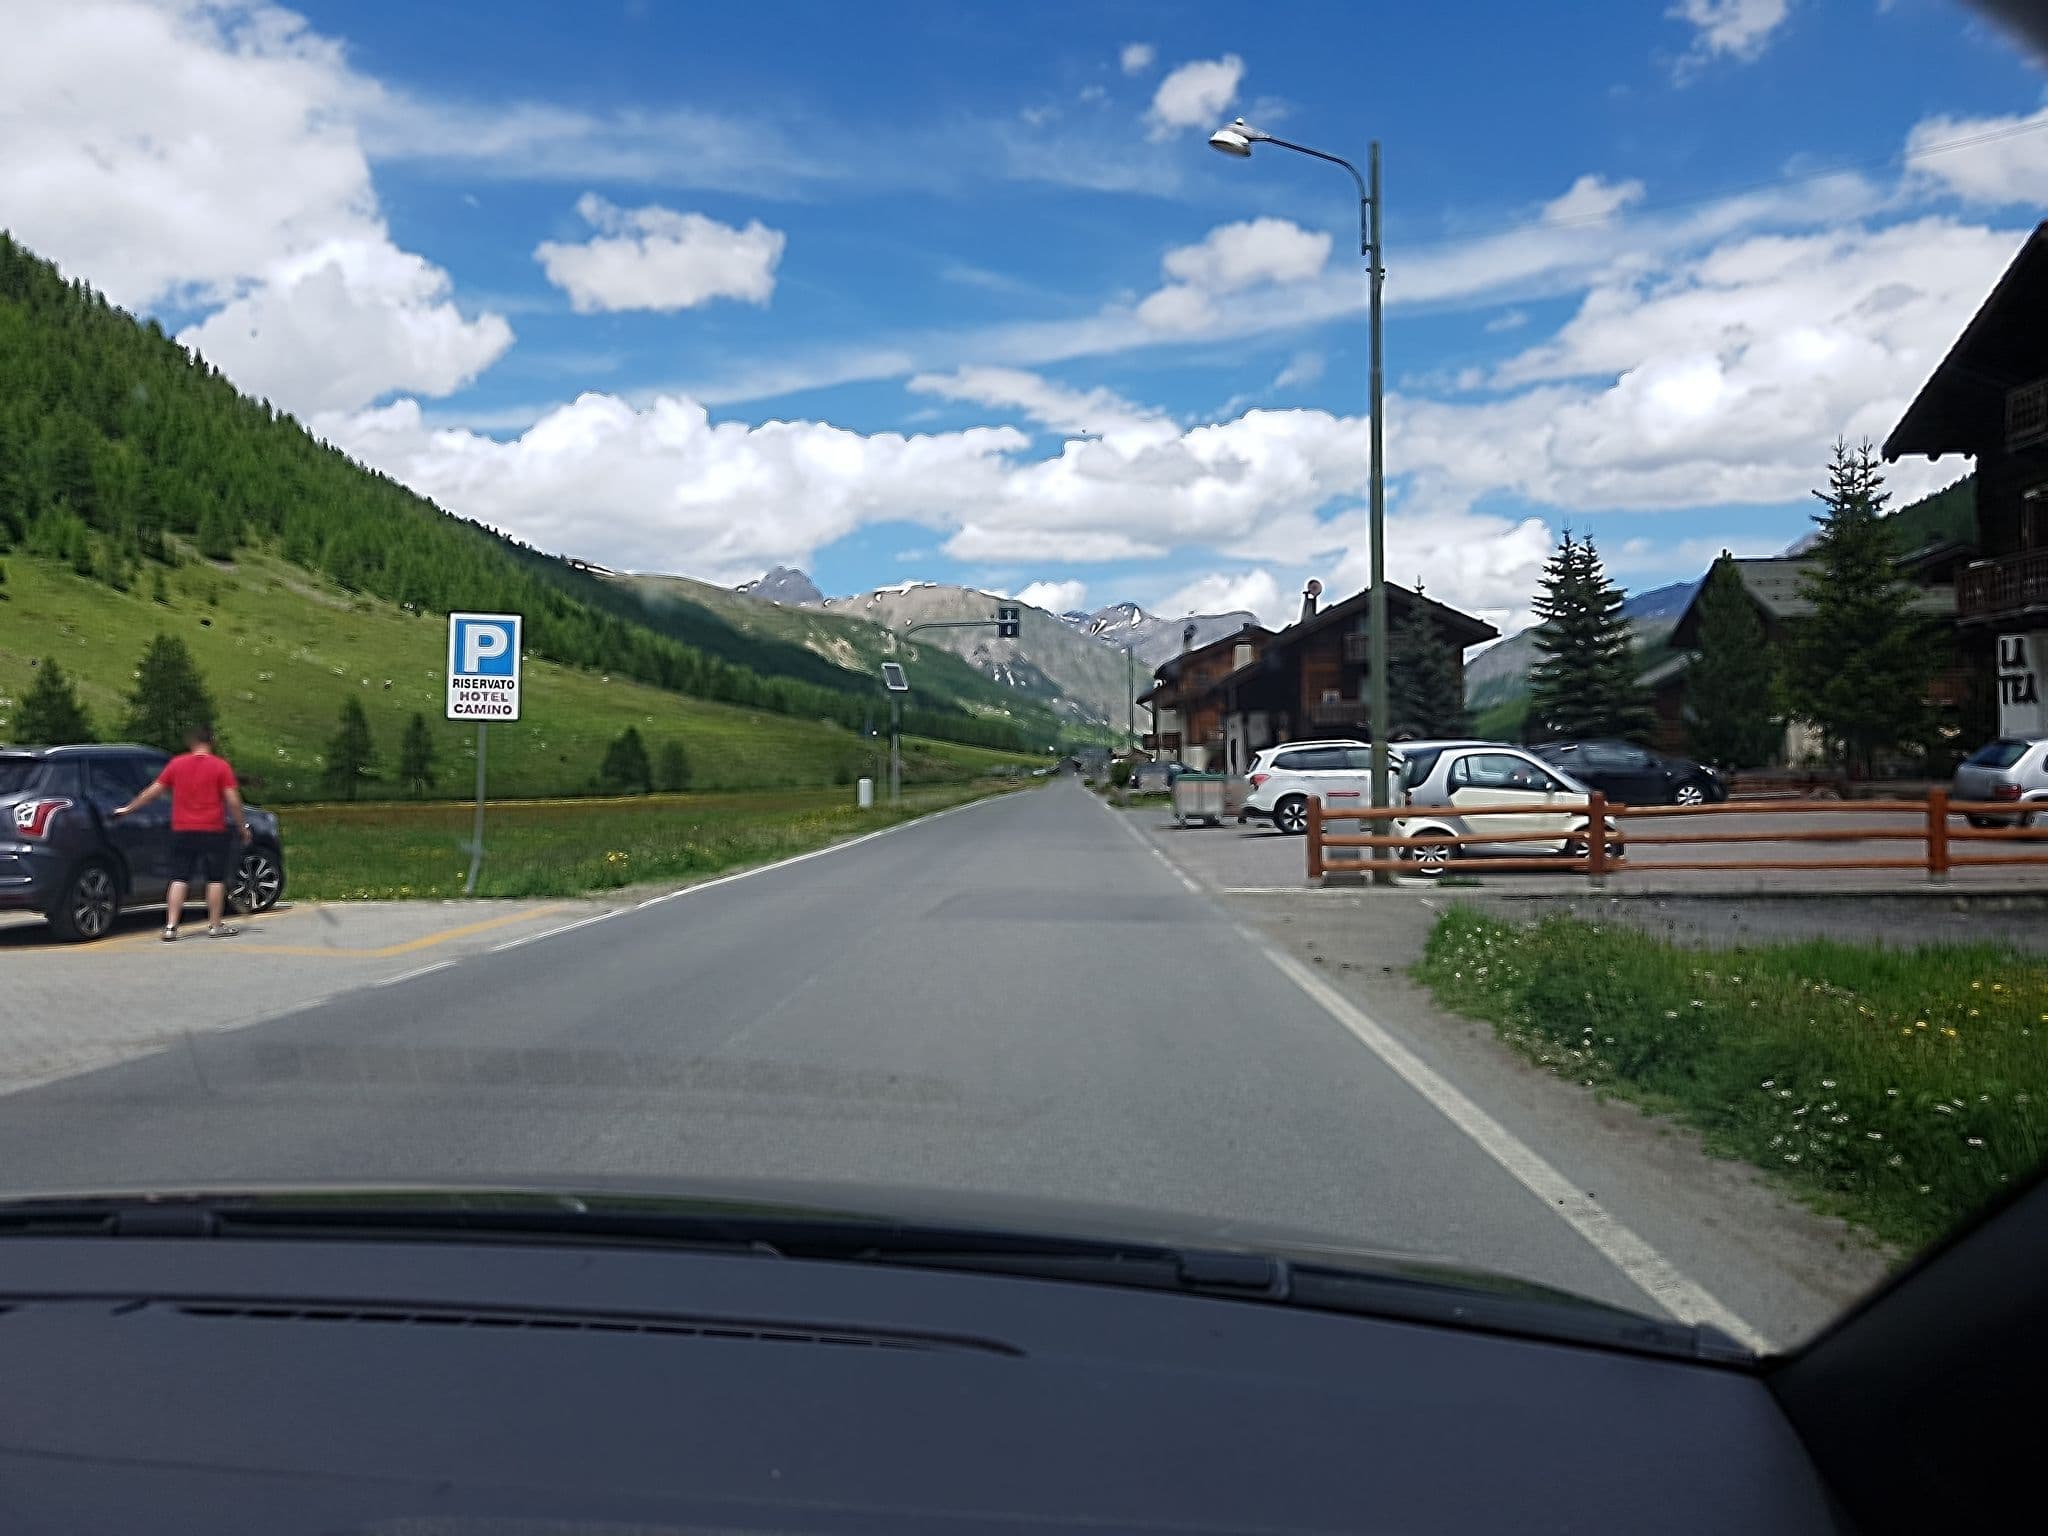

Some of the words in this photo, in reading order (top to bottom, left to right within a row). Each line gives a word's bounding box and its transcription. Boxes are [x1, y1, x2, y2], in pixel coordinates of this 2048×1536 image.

[464, 624, 508, 672] P
[452, 678, 515, 689] RISERVATO
[459, 691, 508, 702] HOTEL
[453, 704, 512, 715] CAMINO
